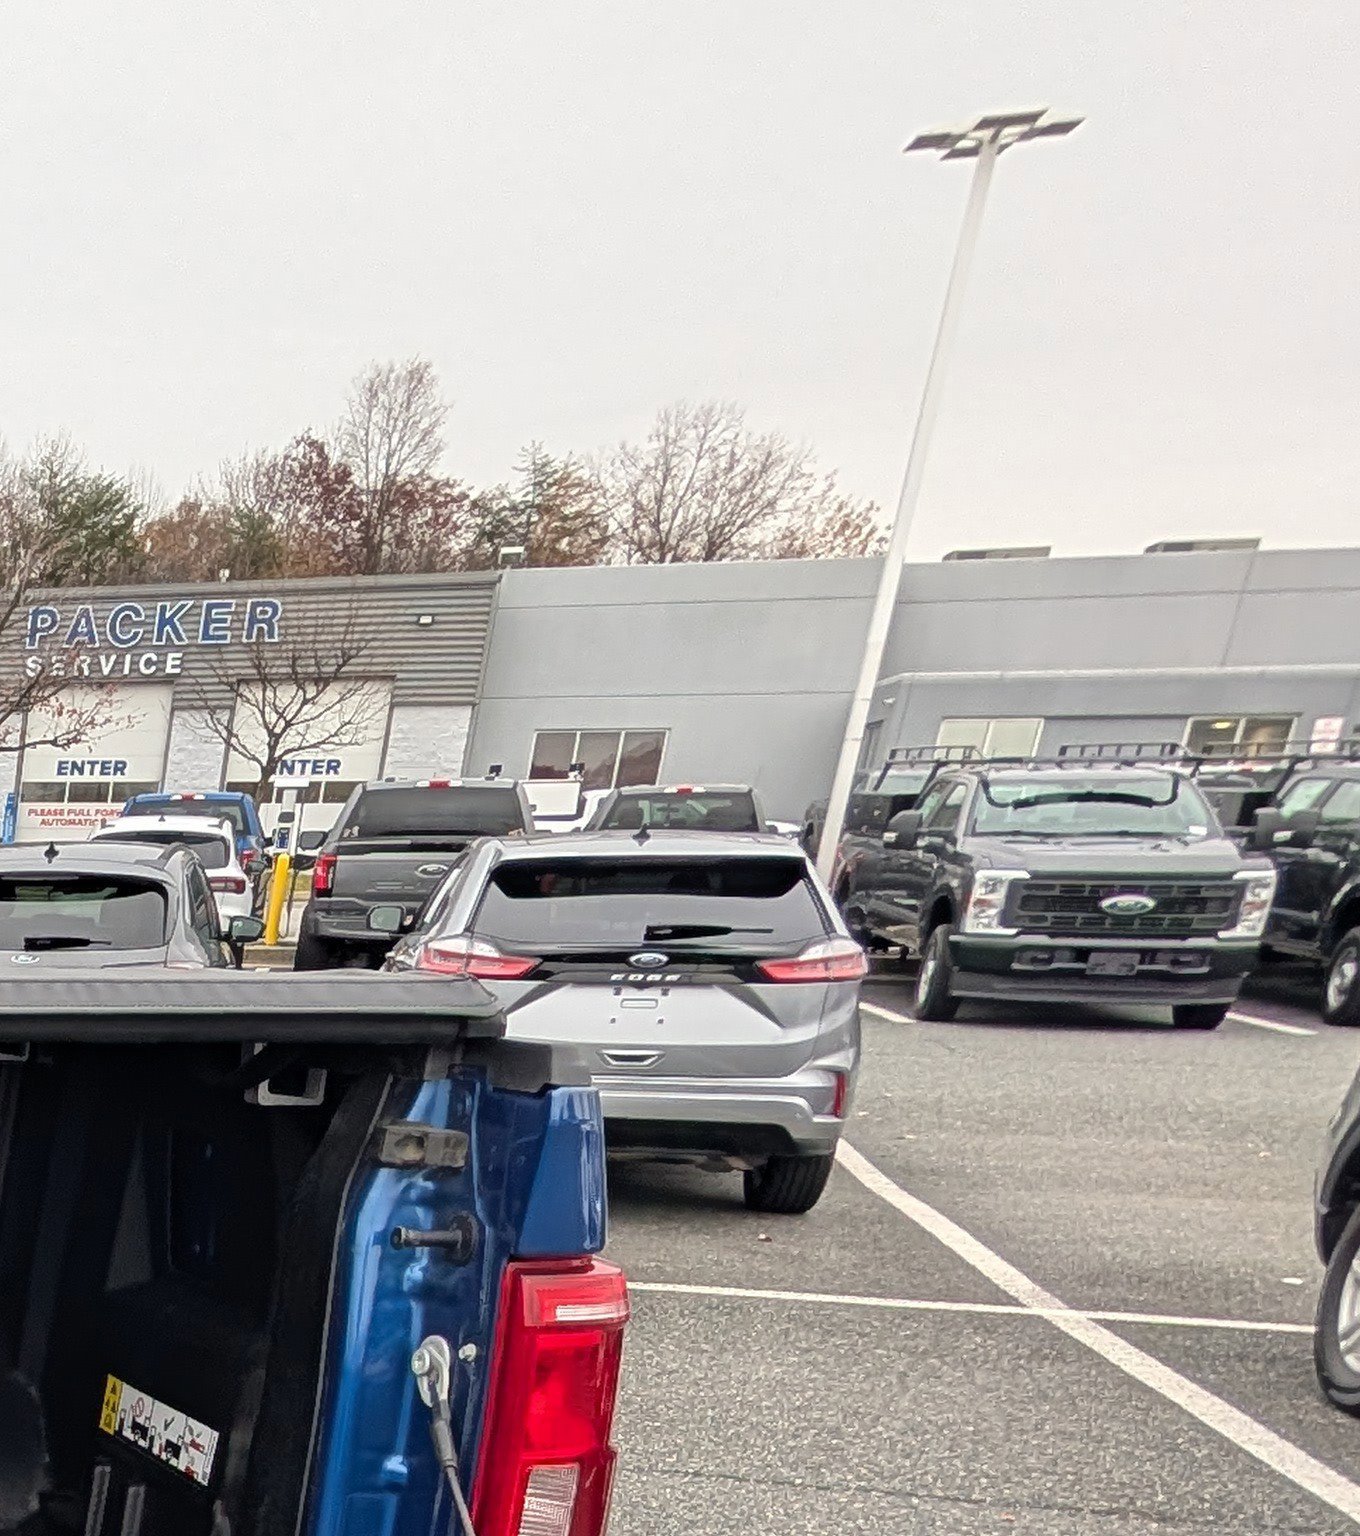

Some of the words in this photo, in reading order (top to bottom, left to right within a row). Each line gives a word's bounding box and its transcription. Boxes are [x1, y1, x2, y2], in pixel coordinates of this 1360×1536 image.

[25, 599, 282, 649] PACKER
[24, 652, 184, 678] SERVICE
[56, 759, 128, 776] ENTER
[269, 759, 342, 776] NTER
[27, 808, 65, 817] PLEASE
